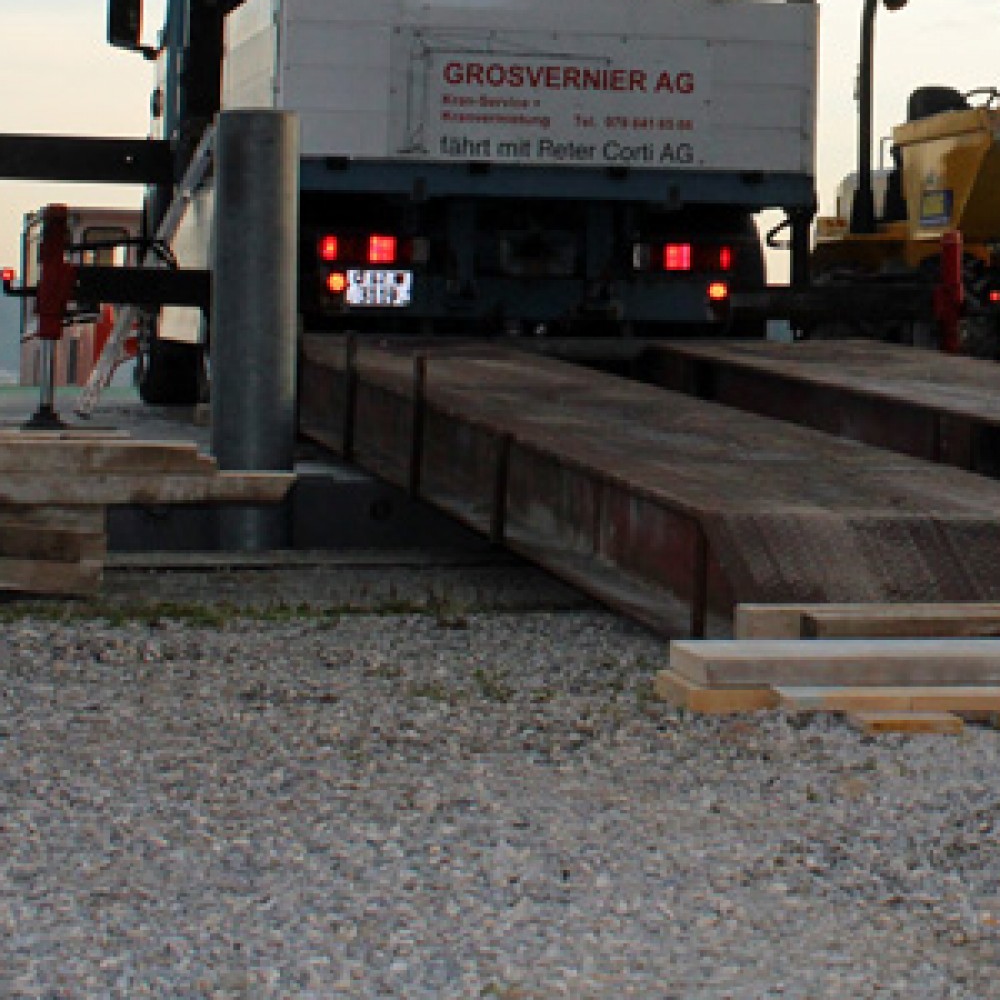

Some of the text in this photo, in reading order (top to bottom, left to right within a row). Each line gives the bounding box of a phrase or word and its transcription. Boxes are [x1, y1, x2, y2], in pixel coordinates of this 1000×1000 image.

[443, 62, 695, 94] GROSVERNIER AG
[439, 135, 694, 163] fährt mit Peter Corti AG
